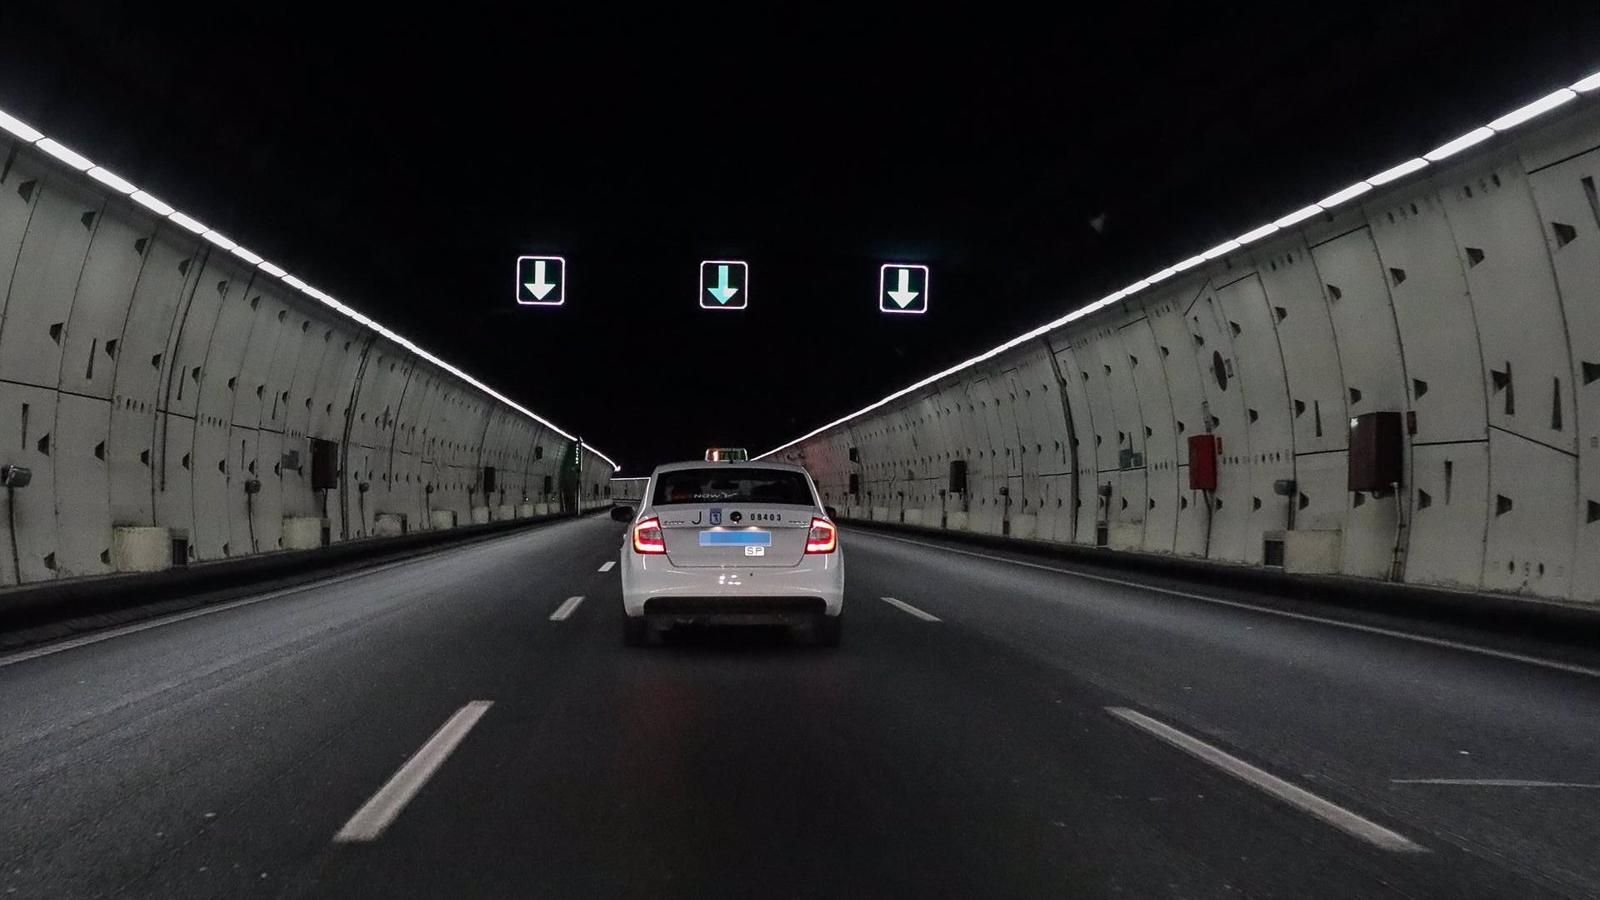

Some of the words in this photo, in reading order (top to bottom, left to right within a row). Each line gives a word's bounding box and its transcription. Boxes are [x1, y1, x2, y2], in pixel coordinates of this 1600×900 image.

[692, 511, 702, 525] J
[750, 513, 781, 521] 08403
[746, 547, 763, 555] SP
